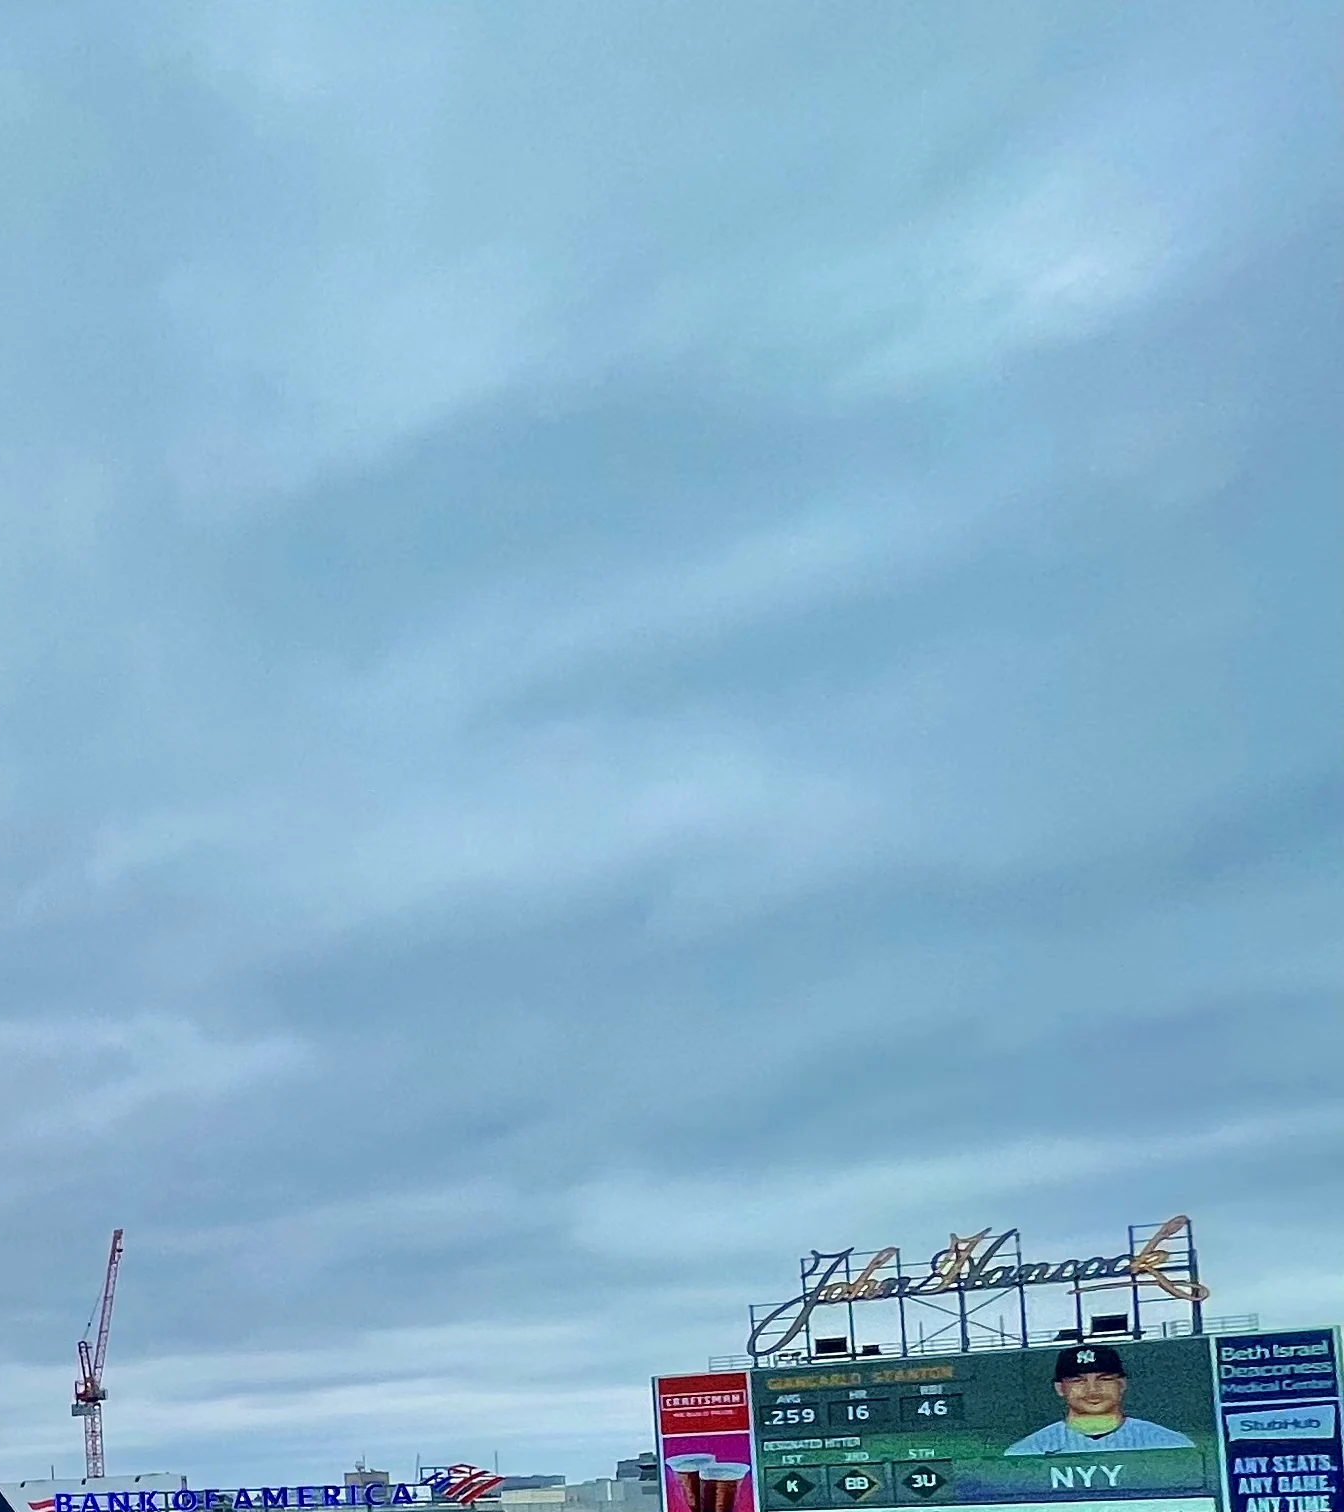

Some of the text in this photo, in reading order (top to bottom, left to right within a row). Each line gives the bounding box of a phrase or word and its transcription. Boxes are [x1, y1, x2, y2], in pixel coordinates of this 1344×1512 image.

[746, 1215, 1210, 1356] John Hancock
[1220, 1340, 1329, 1362] Beth Israel
[1220, 1361, 1332, 1379] Deaconess
[764, 1408, 816, 1425] .259
[846, 1404, 870, 1420] 16
[917, 1400, 948, 1416] 46
[1233, 1456, 1272, 1474] ANY
[911, 1473, 937, 1488] 3U
[1050, 1464, 1124, 1489] NYY
[1238, 1476, 1274, 1495] ANY
[786, 1479, 799, 1493] K
[172, 1488, 220, 1512] OF
[232, 1482, 414, 1510] AMERICA
